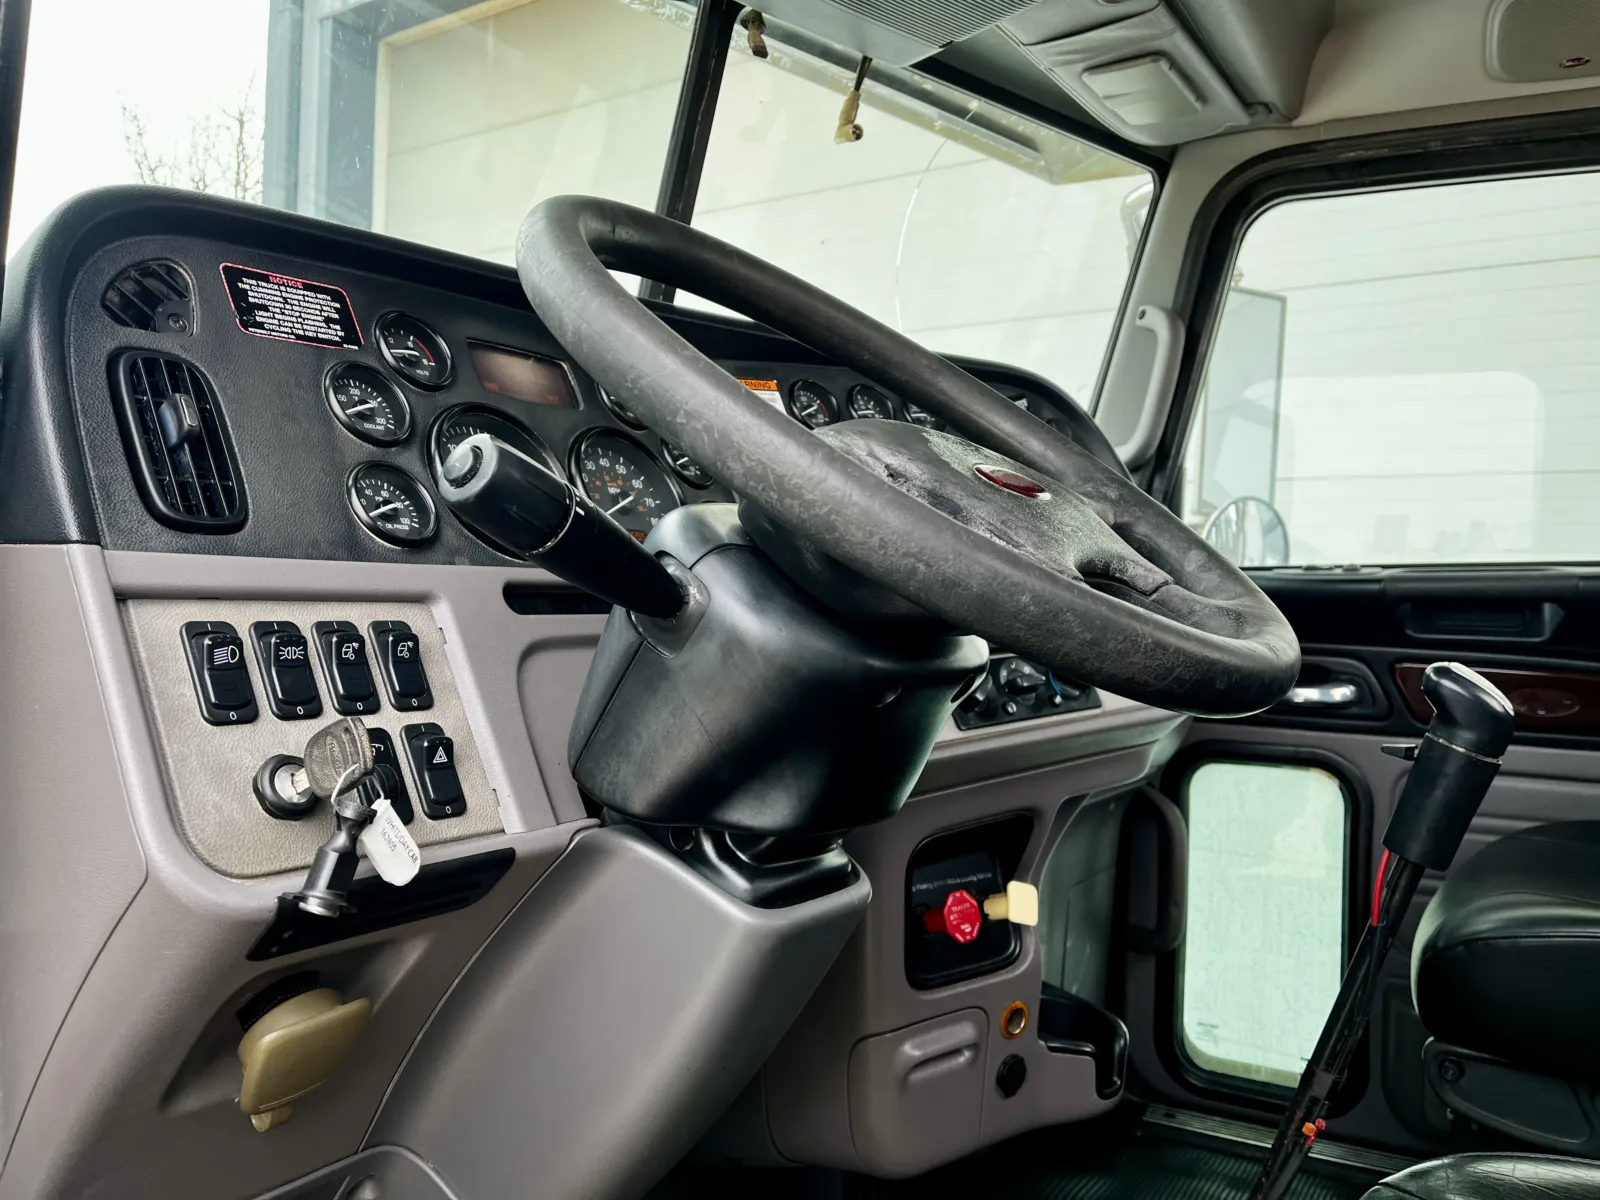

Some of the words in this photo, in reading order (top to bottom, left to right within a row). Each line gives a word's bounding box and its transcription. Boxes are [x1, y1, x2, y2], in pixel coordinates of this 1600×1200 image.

[269, 276, 303, 289] NOTICE
[242, 277, 257, 286] THIS
[257, 280, 279, 290] TRUCK
[279, 284, 286, 292] IS
[286, 286, 316, 298] EQUIPPED
[315, 292, 332, 301] WITH
[237, 282, 251, 291] THE
[251, 285, 281, 296] CUMMINS
[281, 292, 304, 301] ENGINE
[304, 295, 341, 308] PROTECTION
[248, 297, 285, 309] SHUTDOWN
[292, 305, 321, 316] SECONDS
[321, 310, 340, 320] AFTER
[268, 306, 281, 314] THE
[286, 298, 299, 306] THE
[299, 300, 321, 310] ENGINE
[321, 304, 336, 313] WILL
[254, 309, 273, 318] LIGHT
[274, 313, 297, 322] BEGINS
[329, 323, 341, 331] THE
[255, 316, 279, 325] ENGINE
[279, 320, 293, 328] CAN
[302, 324, 337, 336] RESTARTED
[264, 323, 291, 333] CYCLING
[292, 328, 304, 336] THE
[741, 380, 772, 389] RNING
[348, 387, 361, 396] 200
[336, 394, 347, 402] 150
[375, 417, 387, 425] 300
[363, 423, 385, 431] COOLANT
[584, 460, 596, 470] 30
[599, 458, 610, 467] 40
[615, 465, 627, 474] 50
[631, 479, 643, 489] 60
[380, 490, 389, 498] 60
[607, 486, 620, 494] MPH
[644, 497, 655, 507] 70
[400, 517, 411, 525] 100
[380, 828, 397, 852] 162805
[385, 815, 411, 851] WHITE/DAY
[407, 849, 419, 864] CAB
